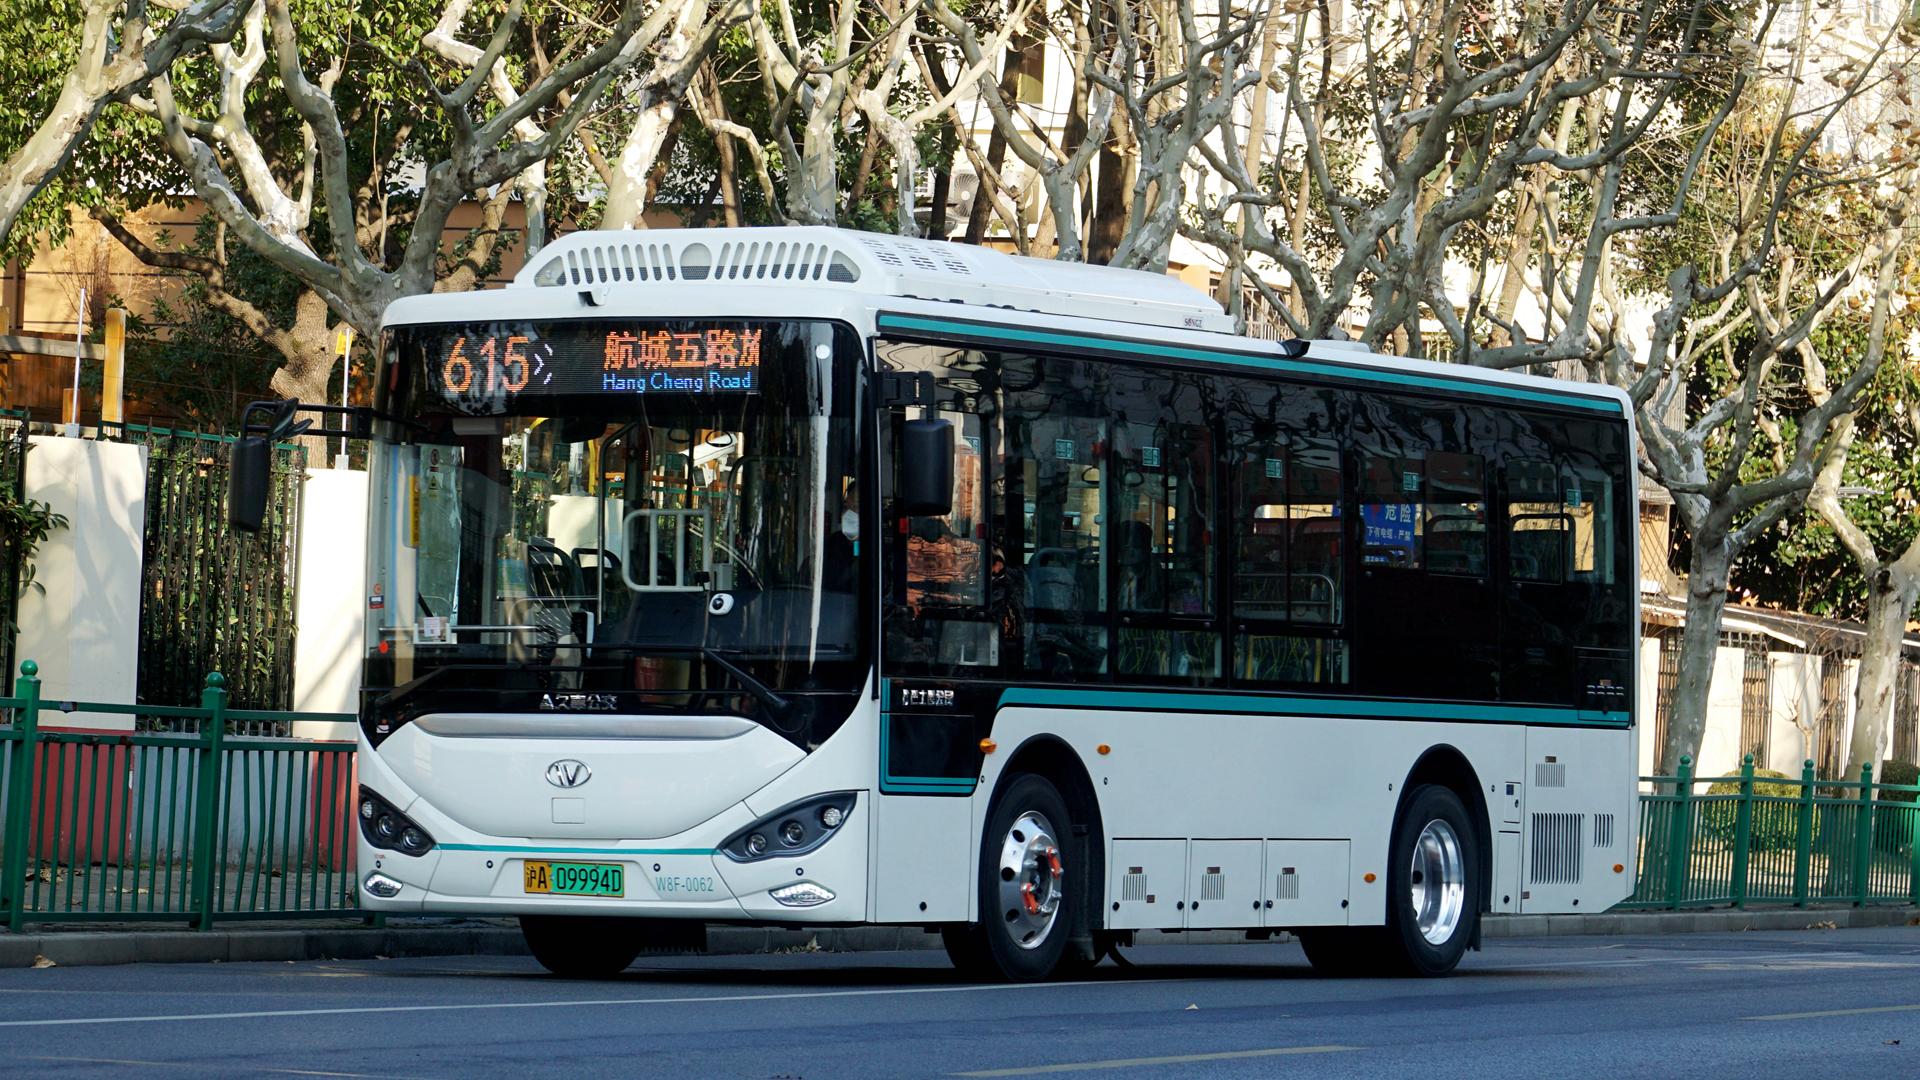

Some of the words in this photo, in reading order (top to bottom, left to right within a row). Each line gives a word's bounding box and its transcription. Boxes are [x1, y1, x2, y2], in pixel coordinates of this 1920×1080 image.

[443, 336, 529, 393] 615
[603, 373, 646, 393] Hang
[650, 372, 704, 392] Cheng
[710, 371, 751, 389] Road
[556, 867, 622, 893] 09994D
[655, 876, 714, 892] W8F-0062
